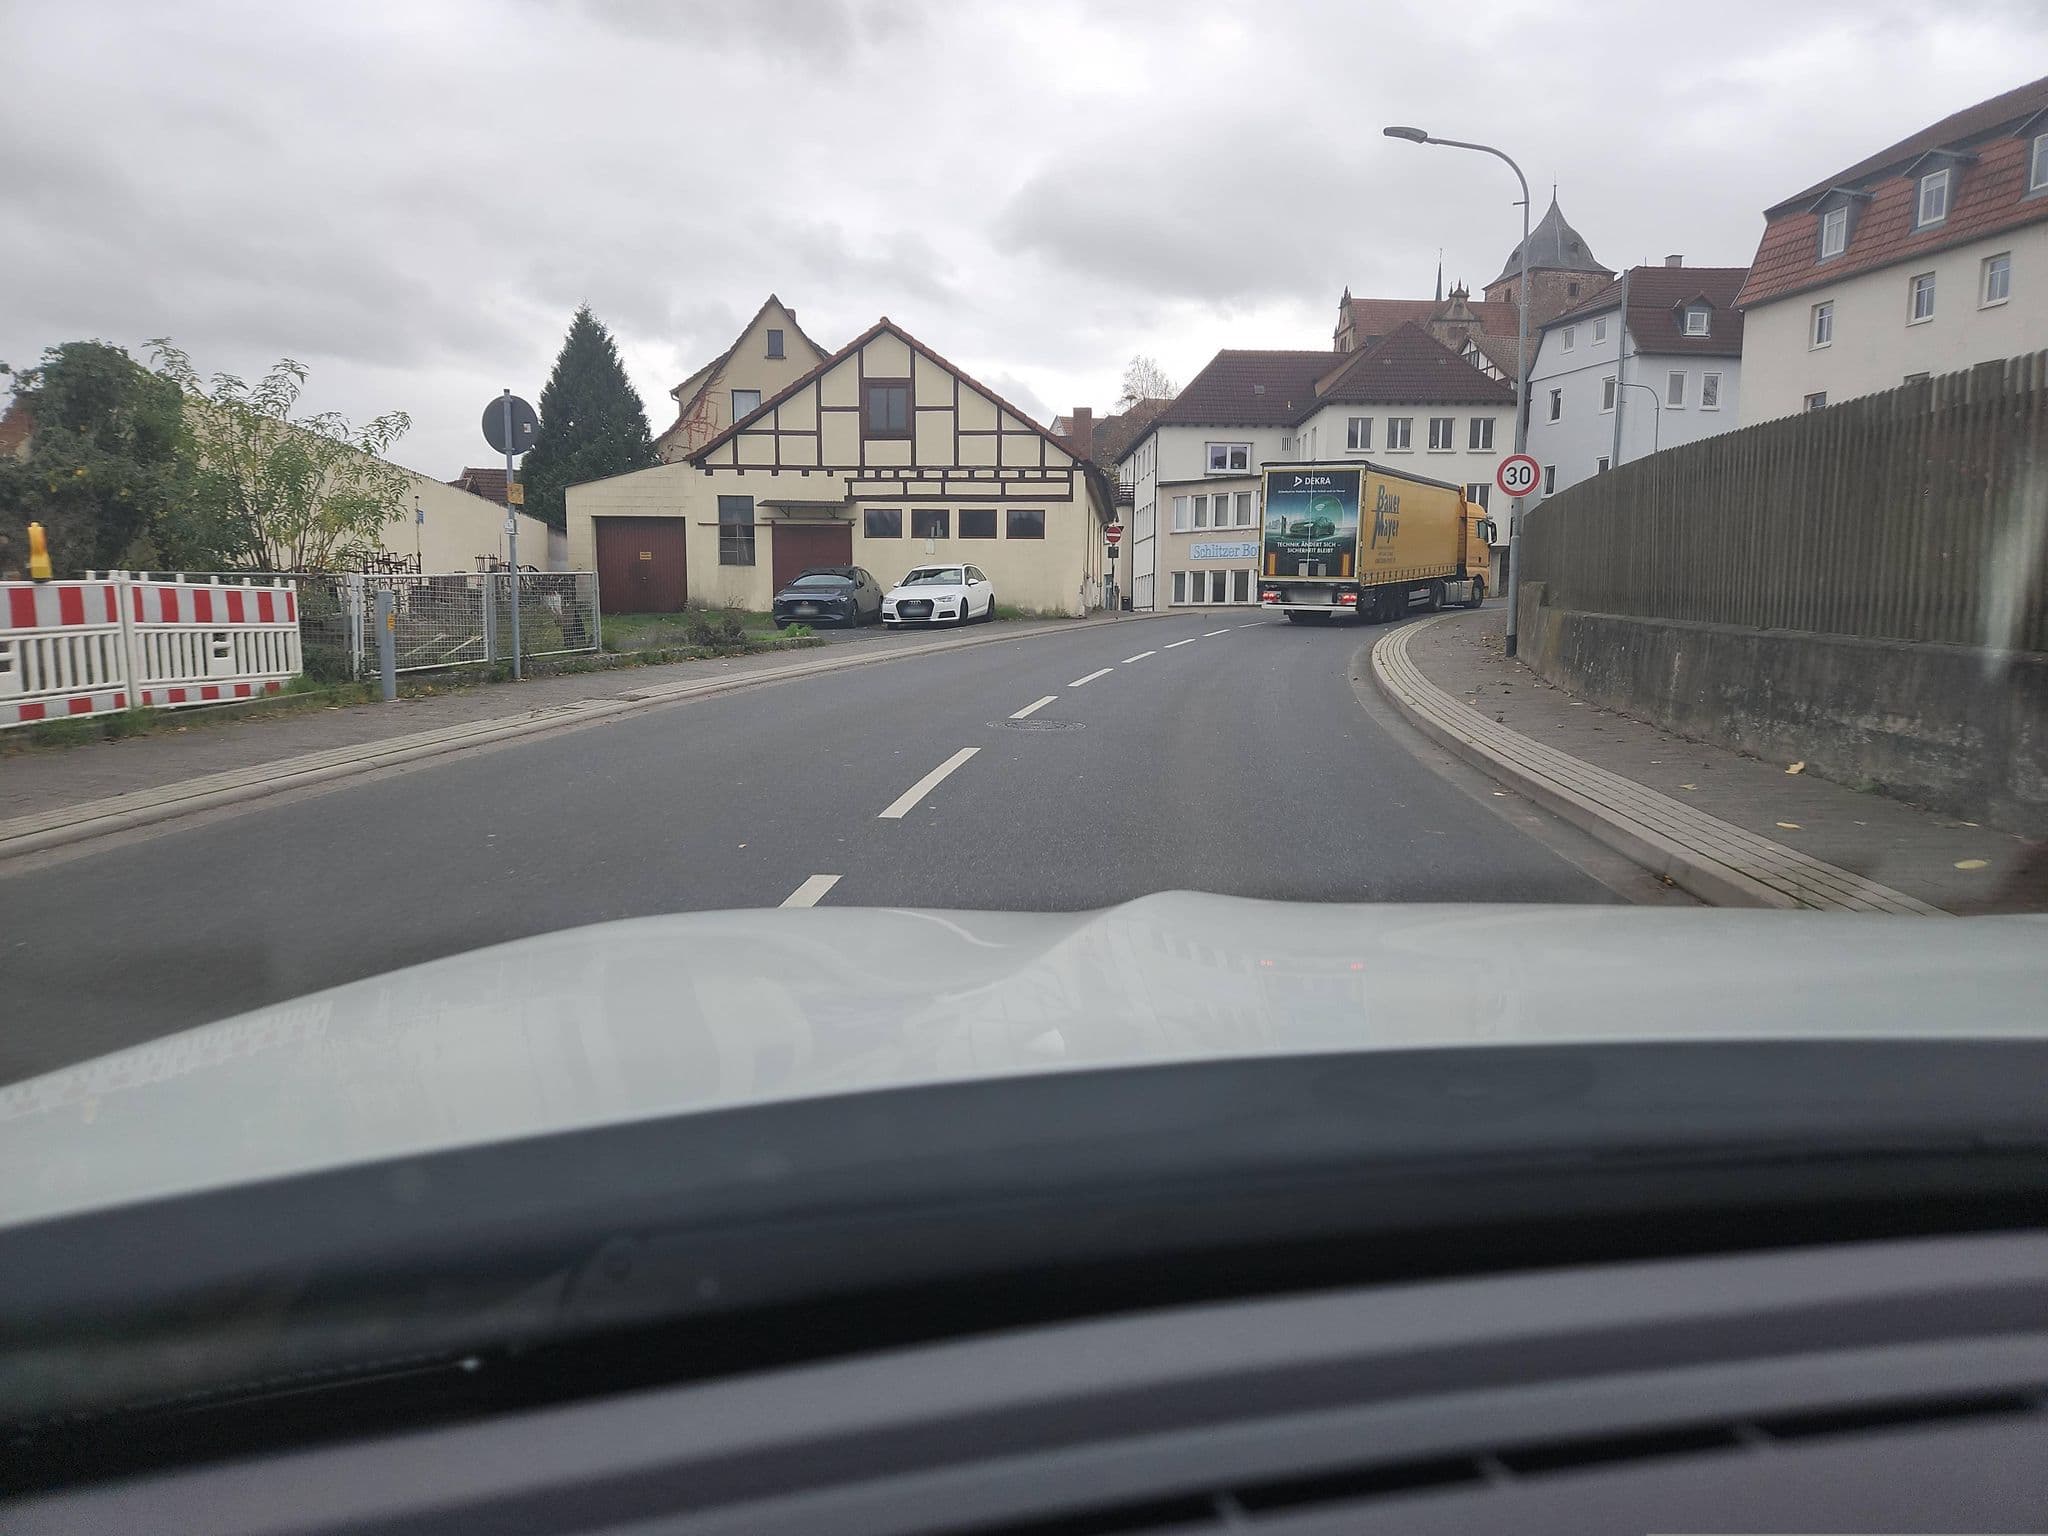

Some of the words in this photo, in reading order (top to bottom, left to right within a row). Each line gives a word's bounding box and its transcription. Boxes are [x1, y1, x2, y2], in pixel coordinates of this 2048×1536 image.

[1304, 476, 1331, 485] DEKRA
[1506, 466, 1530, 485] 30
[1376, 484, 1399, 513] Bauer
[1193, 544, 1240, 559] Schlitzer
